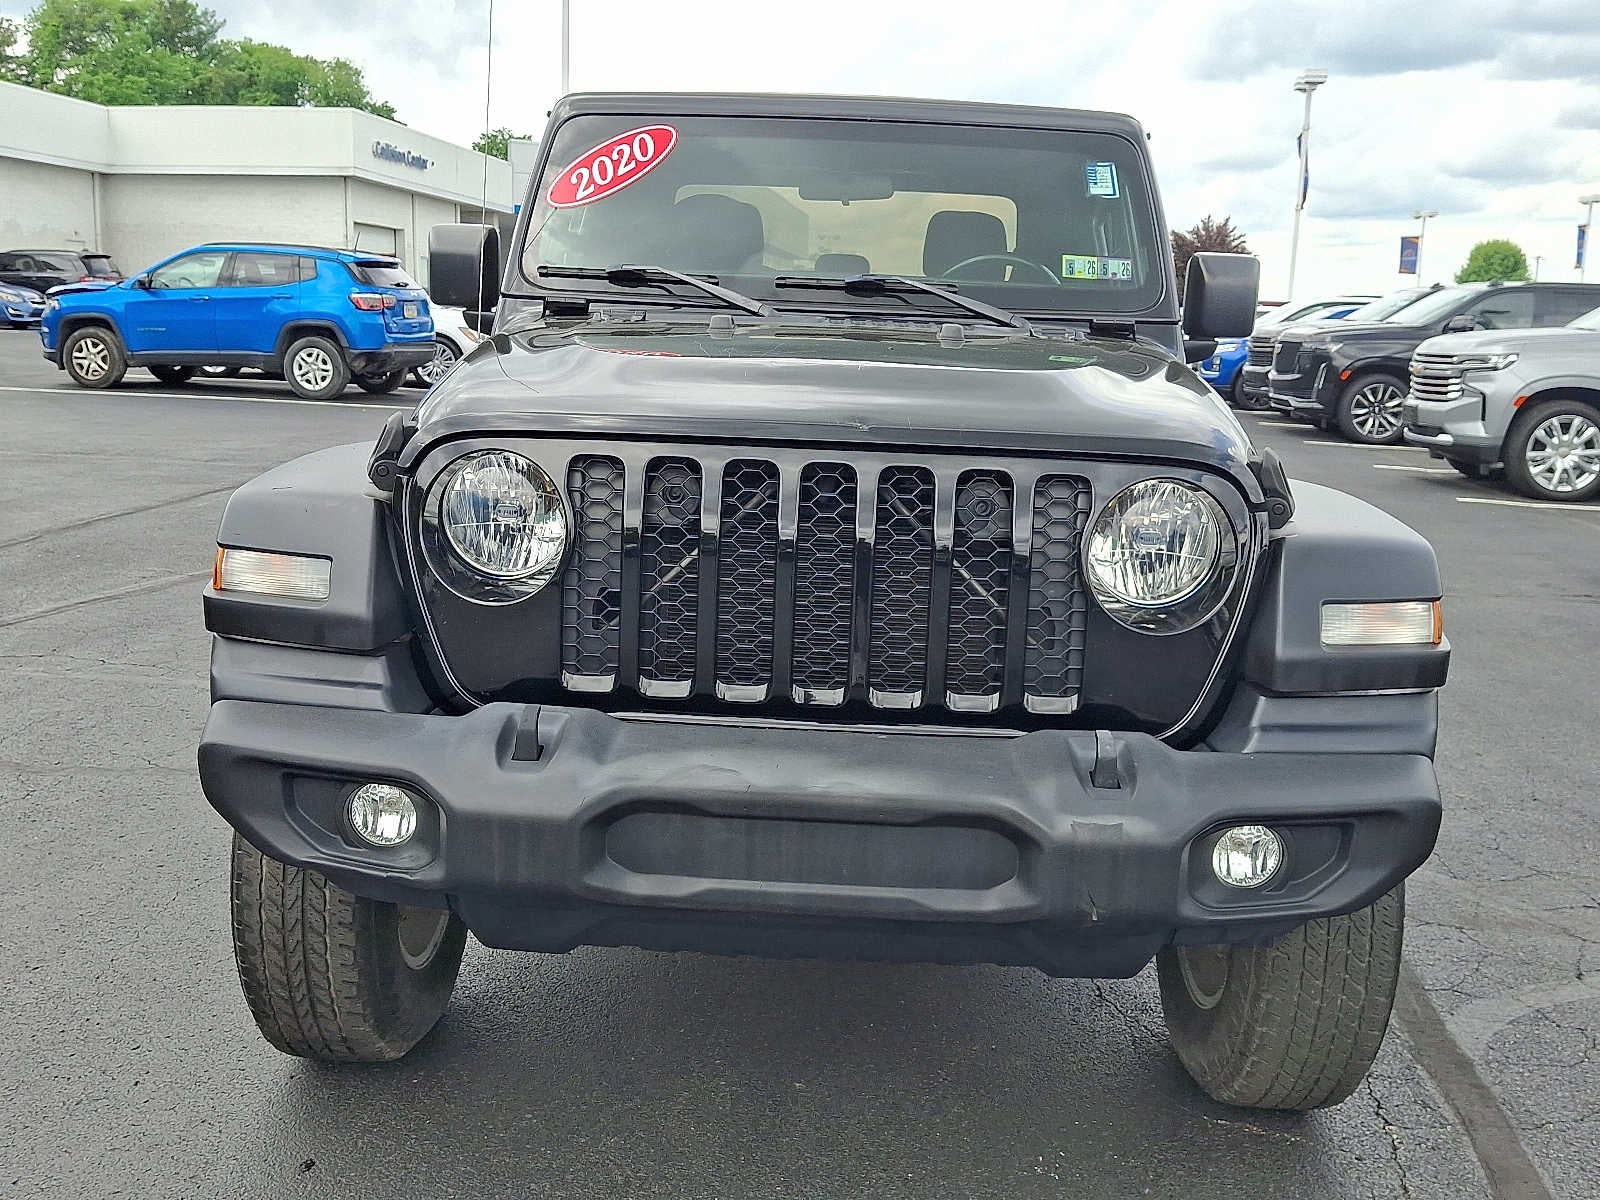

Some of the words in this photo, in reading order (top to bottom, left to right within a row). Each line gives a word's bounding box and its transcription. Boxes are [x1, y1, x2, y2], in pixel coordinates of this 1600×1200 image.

[372, 140, 406, 165] Collision
[406, 150, 429, 169] Center
[570, 132, 655, 200] 2020
[1087, 260, 1096, 275] 26
[1102, 263, 1108, 276] 5
[1121, 262, 1131, 277] 26
